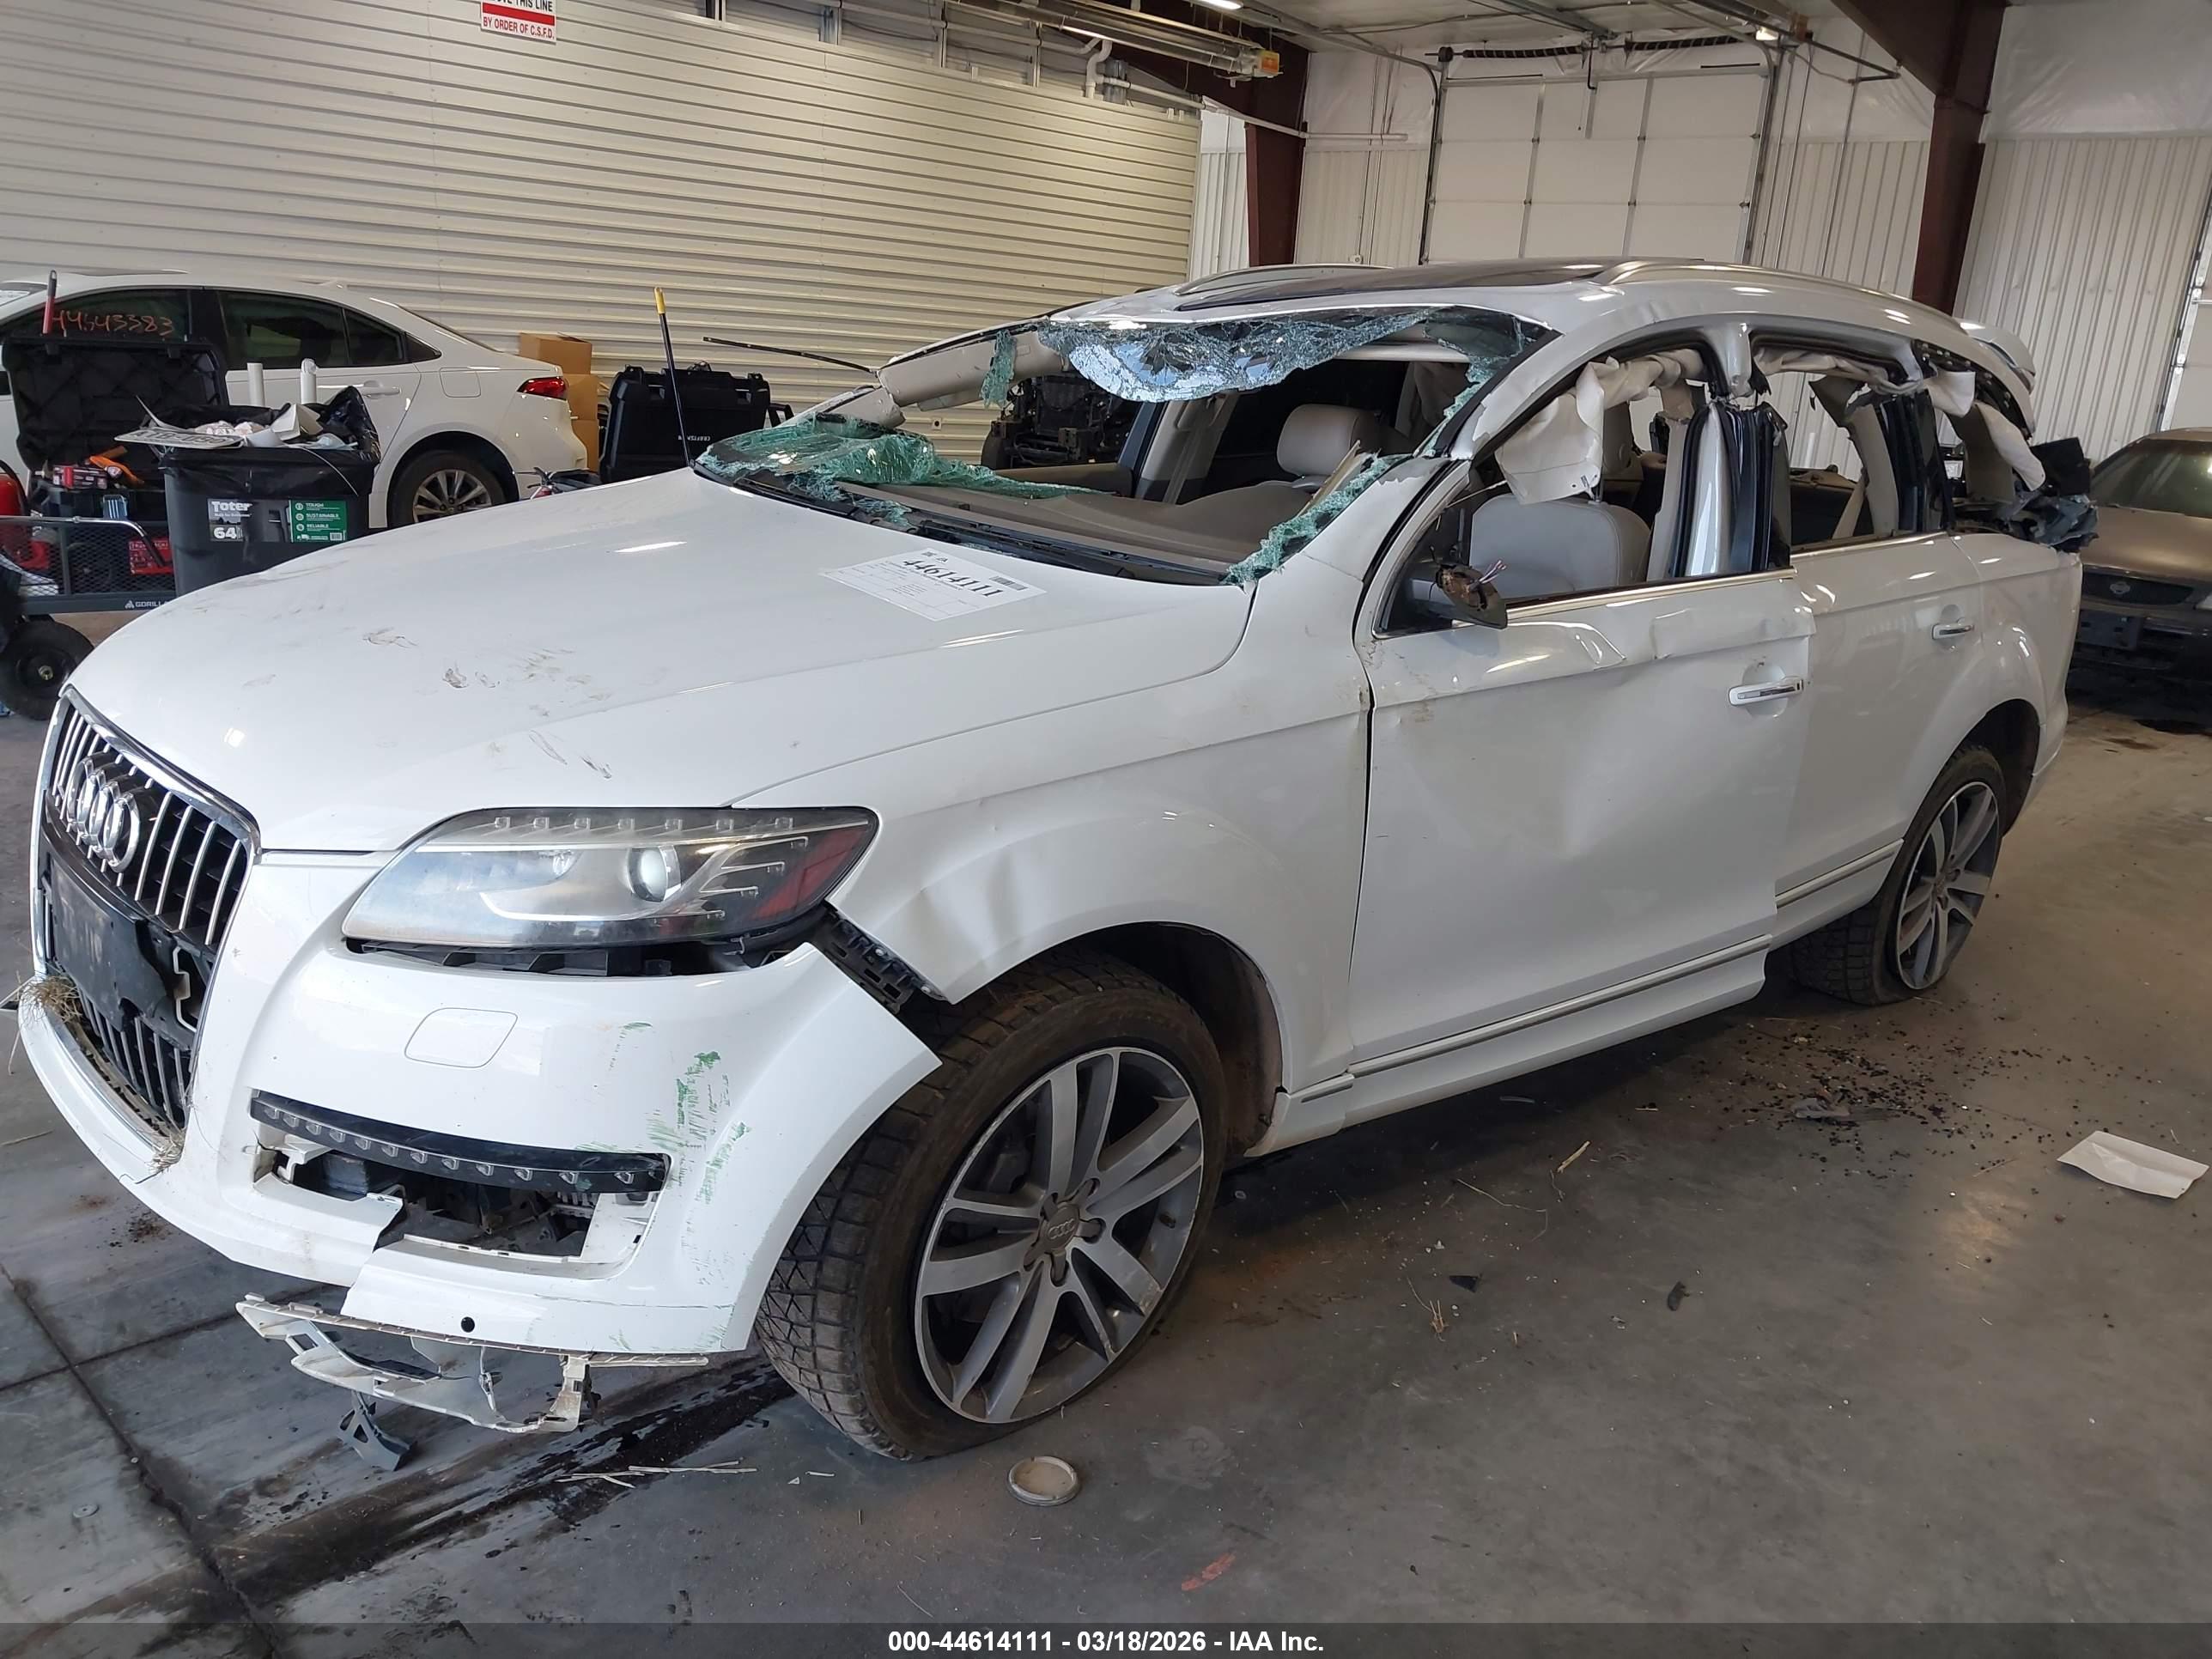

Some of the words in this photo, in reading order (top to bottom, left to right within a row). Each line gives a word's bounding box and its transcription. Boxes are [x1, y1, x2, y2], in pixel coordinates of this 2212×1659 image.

[536, 0, 553, 11] LINE
[483, 16, 492, 27] BY
[495, 19, 518, 32] ORDER
[520, 23, 528, 33] OF
[531, 26, 555, 40] C.S.F.D.
[211, 501, 253, 513] Toter
[213, 526, 237, 539] 64
[902, 560, 1004, 597] 44614111
